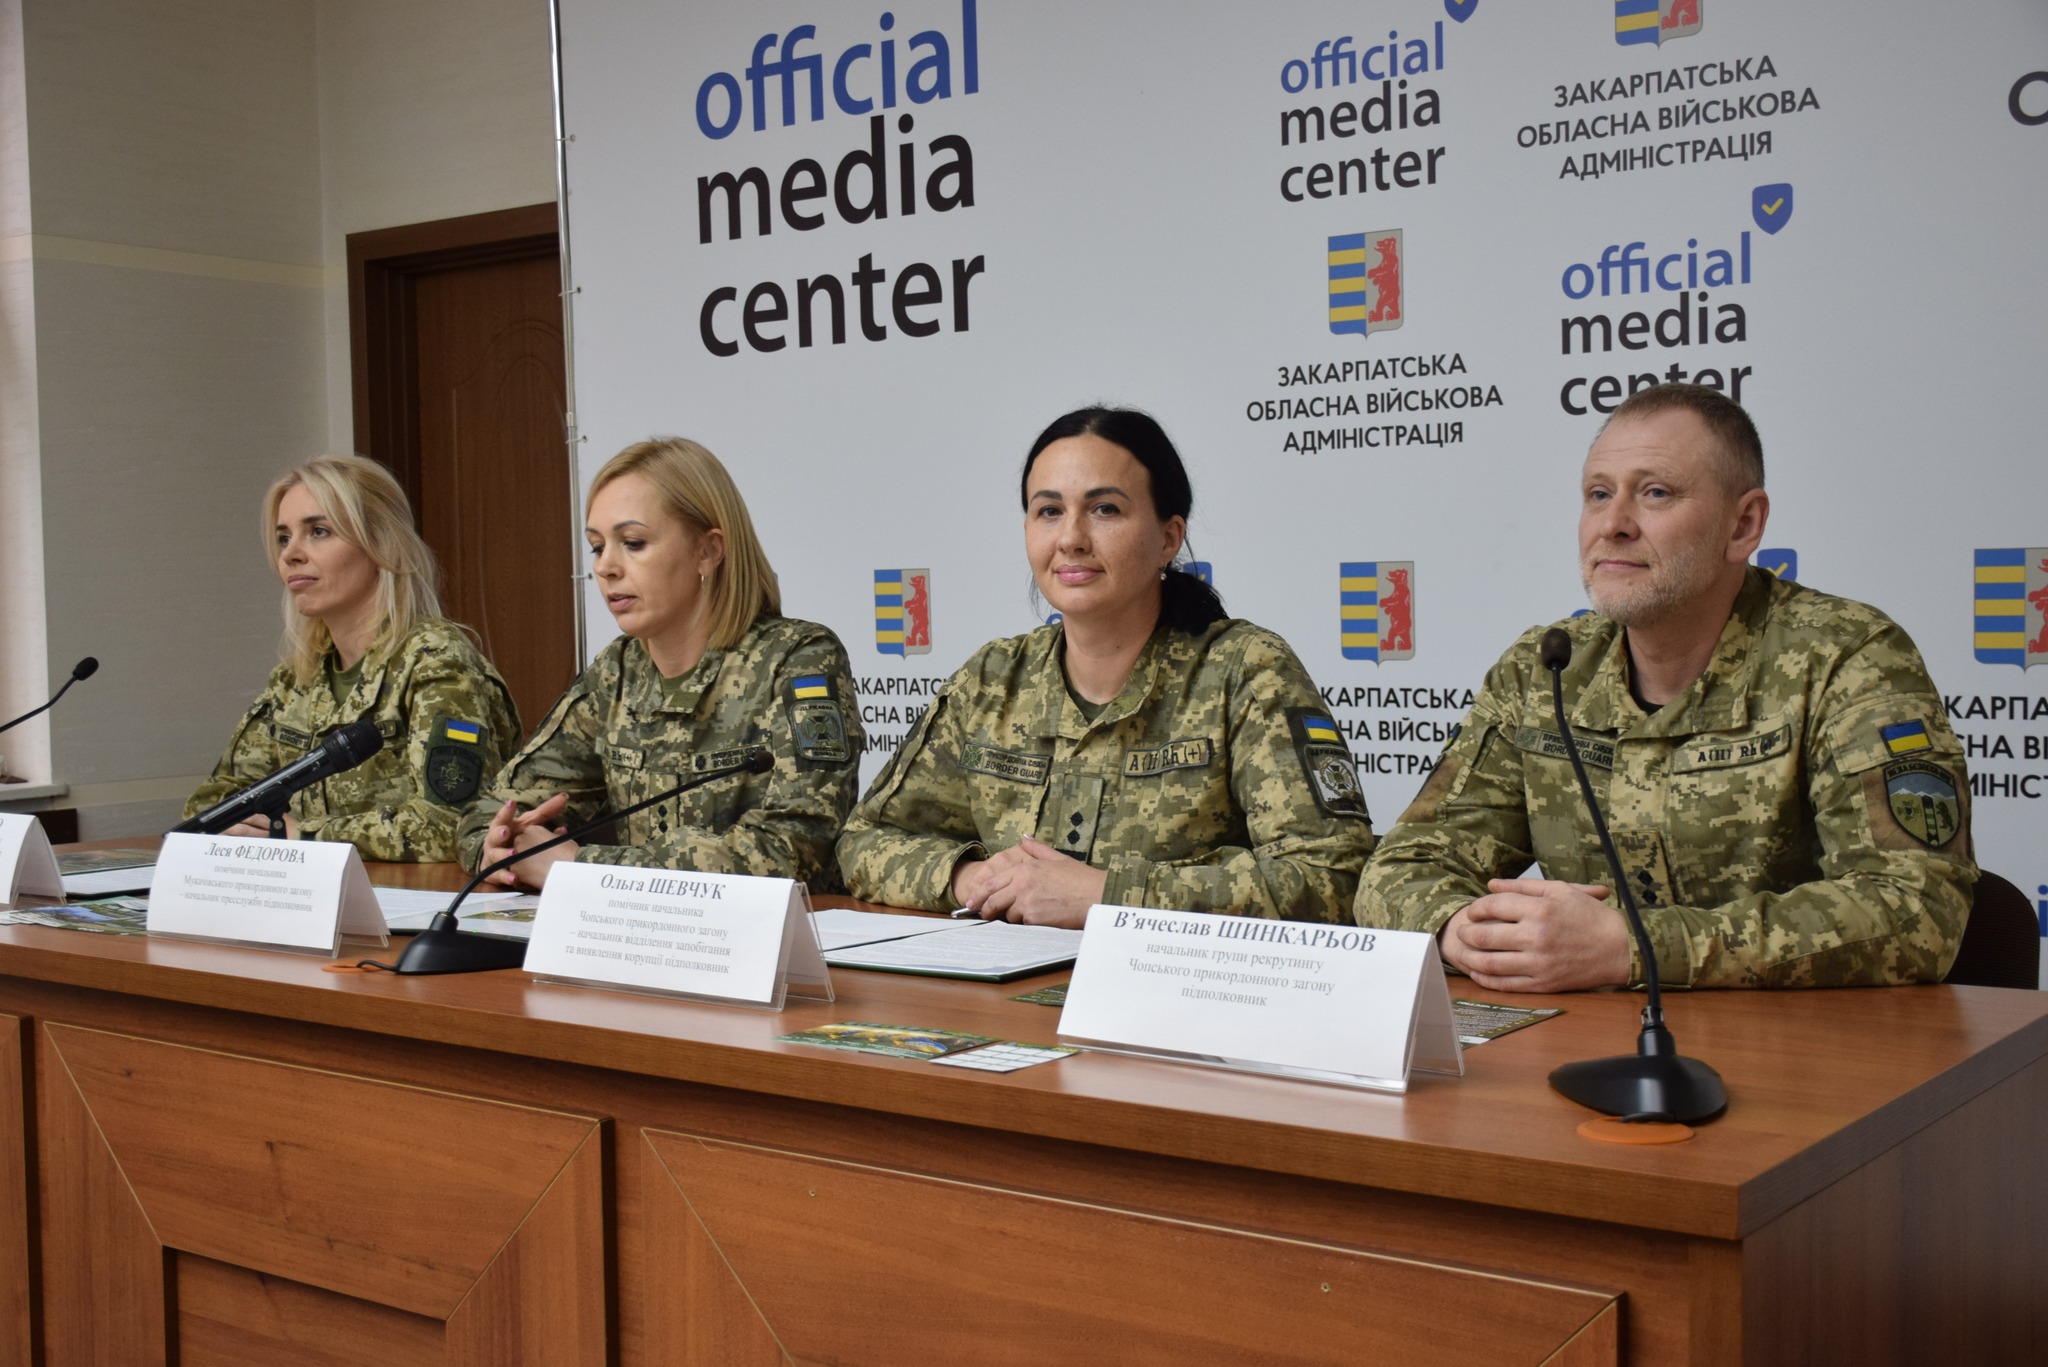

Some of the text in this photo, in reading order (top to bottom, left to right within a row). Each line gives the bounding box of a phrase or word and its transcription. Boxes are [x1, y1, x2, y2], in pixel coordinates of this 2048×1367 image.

[696, 0, 979, 140] official
[1281, 20, 1443, 94] official
[1554, 55, 1777, 108] ЗАКАРПАТСЬКА
[1281, 79, 1440, 146] media
[1517, 87, 1820, 148] ОБЛАСНА ВІЙСЬКОВА
[1559, 130, 1772, 181] АДМІНІСТРАЦІЯ
[697, 113, 975, 245] media
[1280, 146, 1445, 202] center
[1562, 231, 1751, 300] official
[699, 252, 985, 357] center
[1561, 288, 1747, 355] media
[1278, 353, 1467, 387] ЗАКАРПАТСЬКА
[1247, 387, 1504, 422] ОБЛАСНА ВІЙСЬКОВА
[1283, 421, 1463, 455] АДМІНІСТРАЦІЯ
[1321, 687, 1475, 709] КАРПАТСЬКА
[986, 761, 1042, 779] BORDER GUARD
[1162, 744, 1179, 767] Rh
[205, 843, 305, 863] Леся ФЕДОРОВА
[600, 874, 726, 900] Ольга ШЕВЧУК
[608, 899, 704, 917] помічник начальника
[580, 911, 728, 940] Чопського прикордонного загону
[1217, 920, 1377, 952] ШИНКАРЬОВ
[565, 945, 730, 974] та виявлення корупції підполковник
[578, 930, 623, 943] начальник
[625, 933, 672, 949] відділення
[676, 942, 731, 956] запобігання
[1146, 943, 1324, 973] начальник групи рекрутингу
[1129, 958, 1335, 995] Чопського прикордонного загону
[1182, 984, 1268, 1007] підполковник
